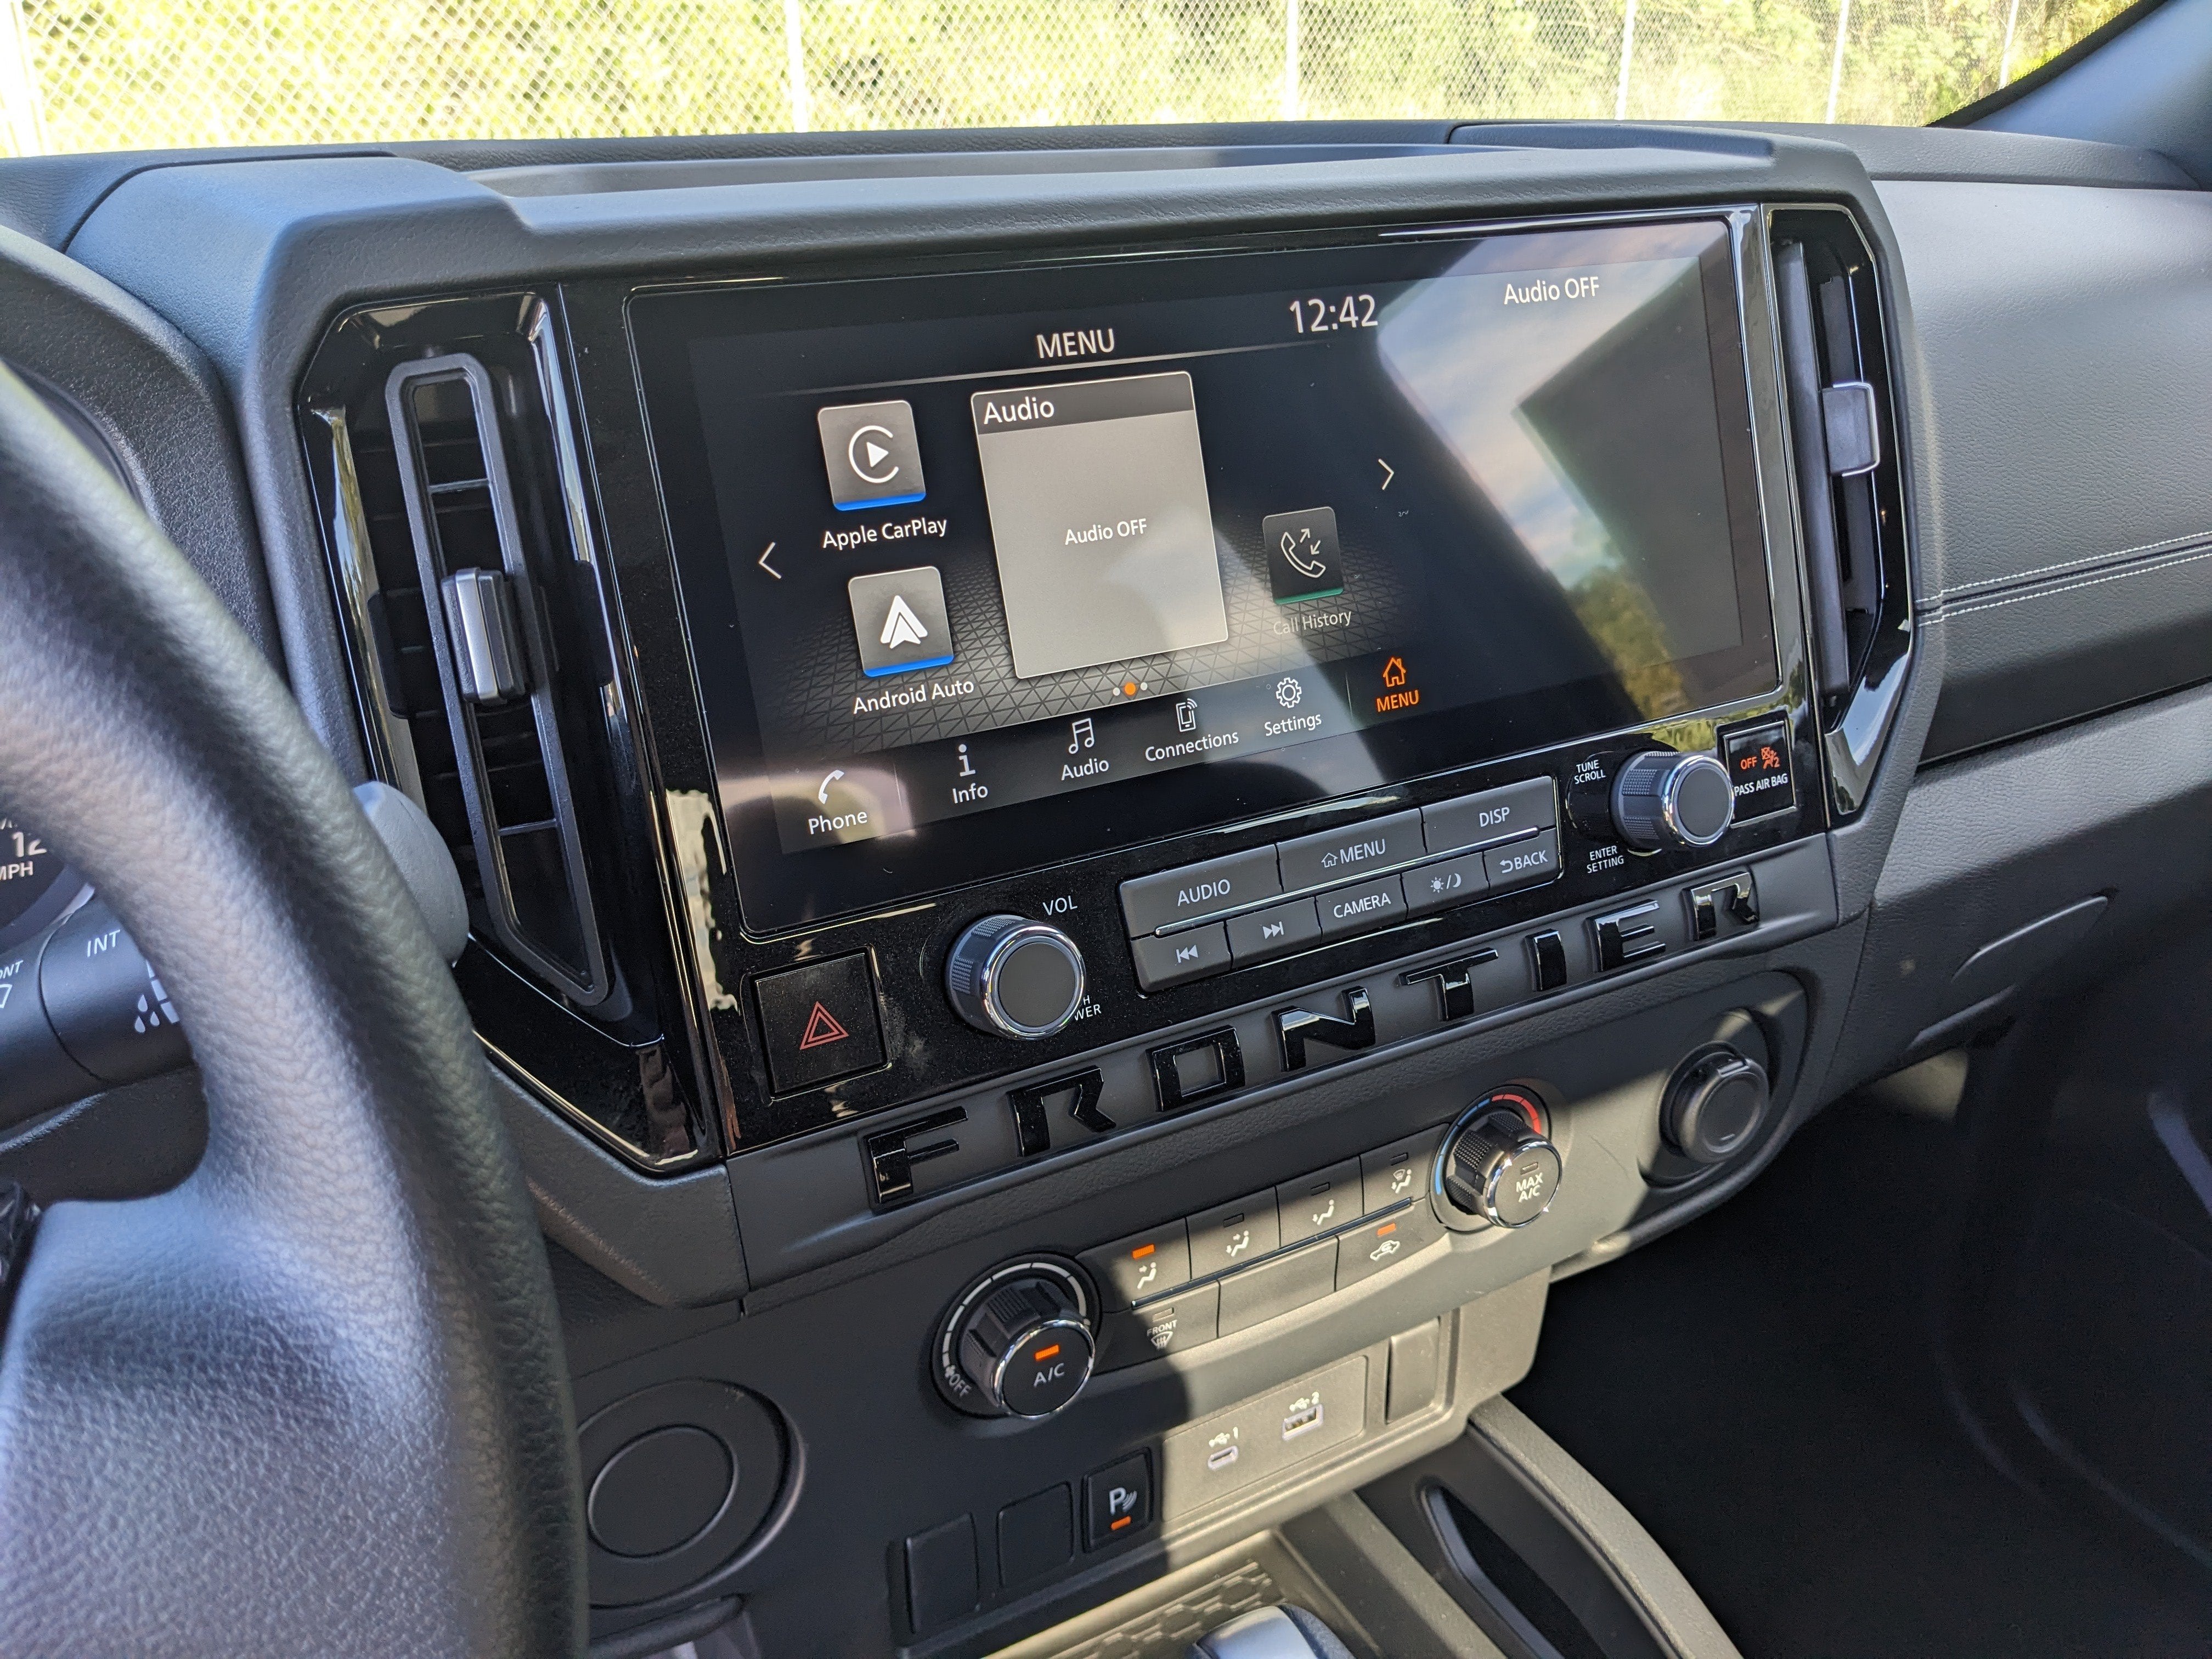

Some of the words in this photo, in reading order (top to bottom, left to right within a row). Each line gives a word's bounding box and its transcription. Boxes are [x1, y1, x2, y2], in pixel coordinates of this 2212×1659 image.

[1503, 278, 1560, 306] Audio
[1565, 276, 1600, 298] OFF
[1289, 295, 1378, 334] 12:42
[1036, 328, 1116, 358] MENU
[983, 397, 1054, 425] Audio
[822, 527, 878, 550] Apple
[882, 517, 947, 541] CarPlay
[1064, 524, 1113, 545] Audio
[1116, 518, 1147, 539] OFF
[1273, 616, 1299, 635] Call
[1302, 610, 1351, 631] History
[853, 685, 927, 714] Android
[932, 680, 974, 701] Auto
[1376, 690, 1420, 713] MENU
[1264, 713, 1322, 737] Settings
[1145, 730, 1239, 762] Connections
[1060, 758, 1109, 780] Audio
[1576, 759, 1599, 773] TUNE
[1740, 757, 1757, 770] OFF
[1574, 770, 1606, 785] SCROLL
[1734, 782, 1755, 797] PASS
[1756, 778, 1770, 791] AIR
[1771, 773, 1788, 787] BAG
[952, 782, 988, 804] Info
[808, 810, 868, 834] Phone
[1479, 806, 1510, 828] DISP
[1339, 838, 1386, 865] MENU
[1514, 850, 1548, 871] BACK
[1589, 845, 1617, 861] ENTER
[1587, 856, 1624, 874] SETTING
[1177, 878, 1231, 906] AUDIO
[1043, 895, 1077, 916] VOL
[1333, 893, 1391, 919] CAMERA
[87, 929, 121, 957] INT
[1074, 1003, 1102, 1021] WER
[865, 871, 1758, 1207] FRONTIER
[1515, 1172, 1543, 1194] MAX
[1519, 1185, 1541, 1204] A/C
[1147, 1319, 1177, 1337] FRONT
[949, 1374, 972, 1397] OFF
[1034, 1363, 1065, 1387] A/C
